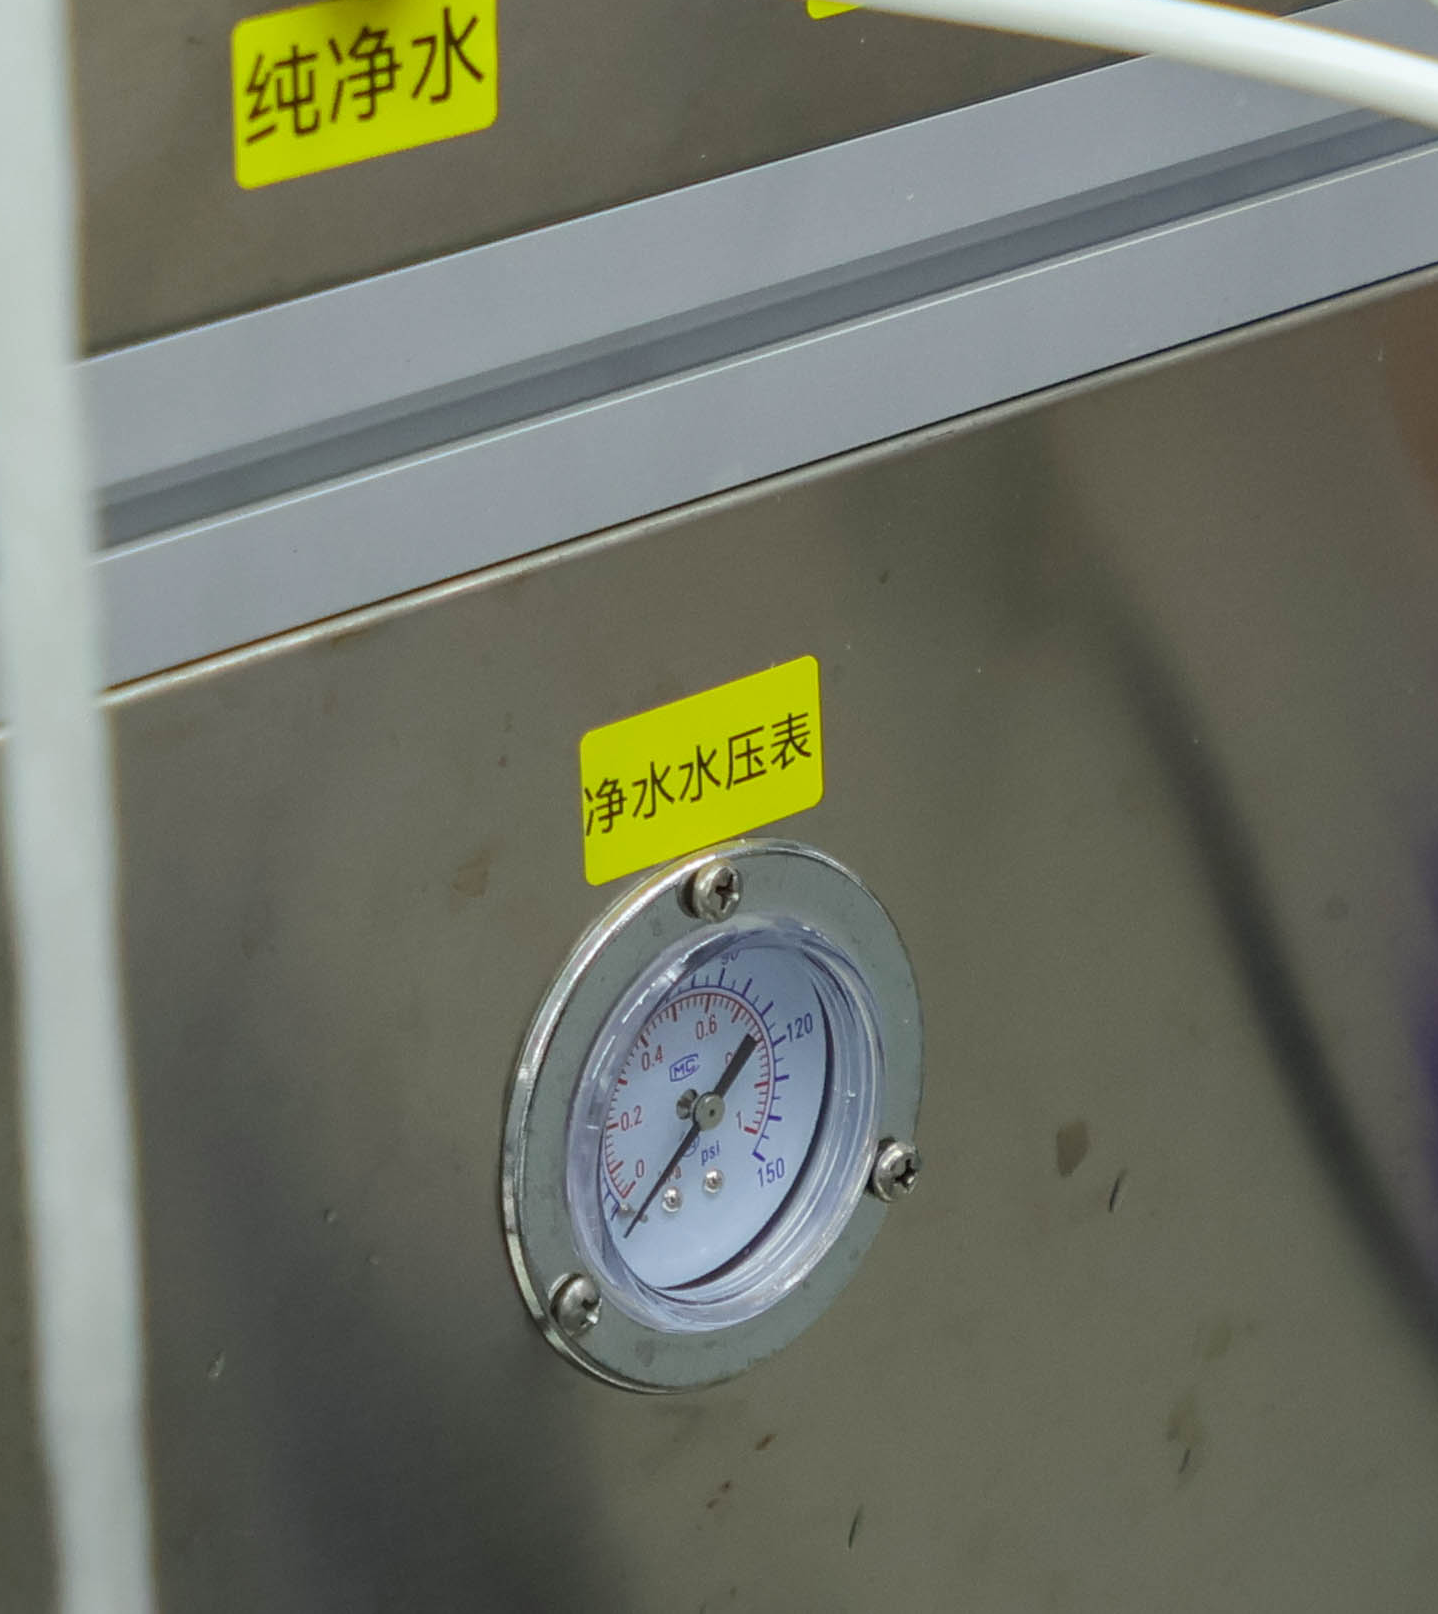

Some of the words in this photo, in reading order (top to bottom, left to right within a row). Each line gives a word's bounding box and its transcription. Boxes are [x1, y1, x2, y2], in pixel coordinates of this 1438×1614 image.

[245, 6, 485, 145] 纯净水
[584, 711, 813, 837] 净水水压表
[695, 1016, 718, 1040] 0.6
[787, 1013, 814, 1042] 120
[641, 1045, 663, 1071] 0.4
[620, 1105, 642, 1132] 0.2
[700, 1140, 721, 1166] psi
[756, 1158, 785, 1188] 150
